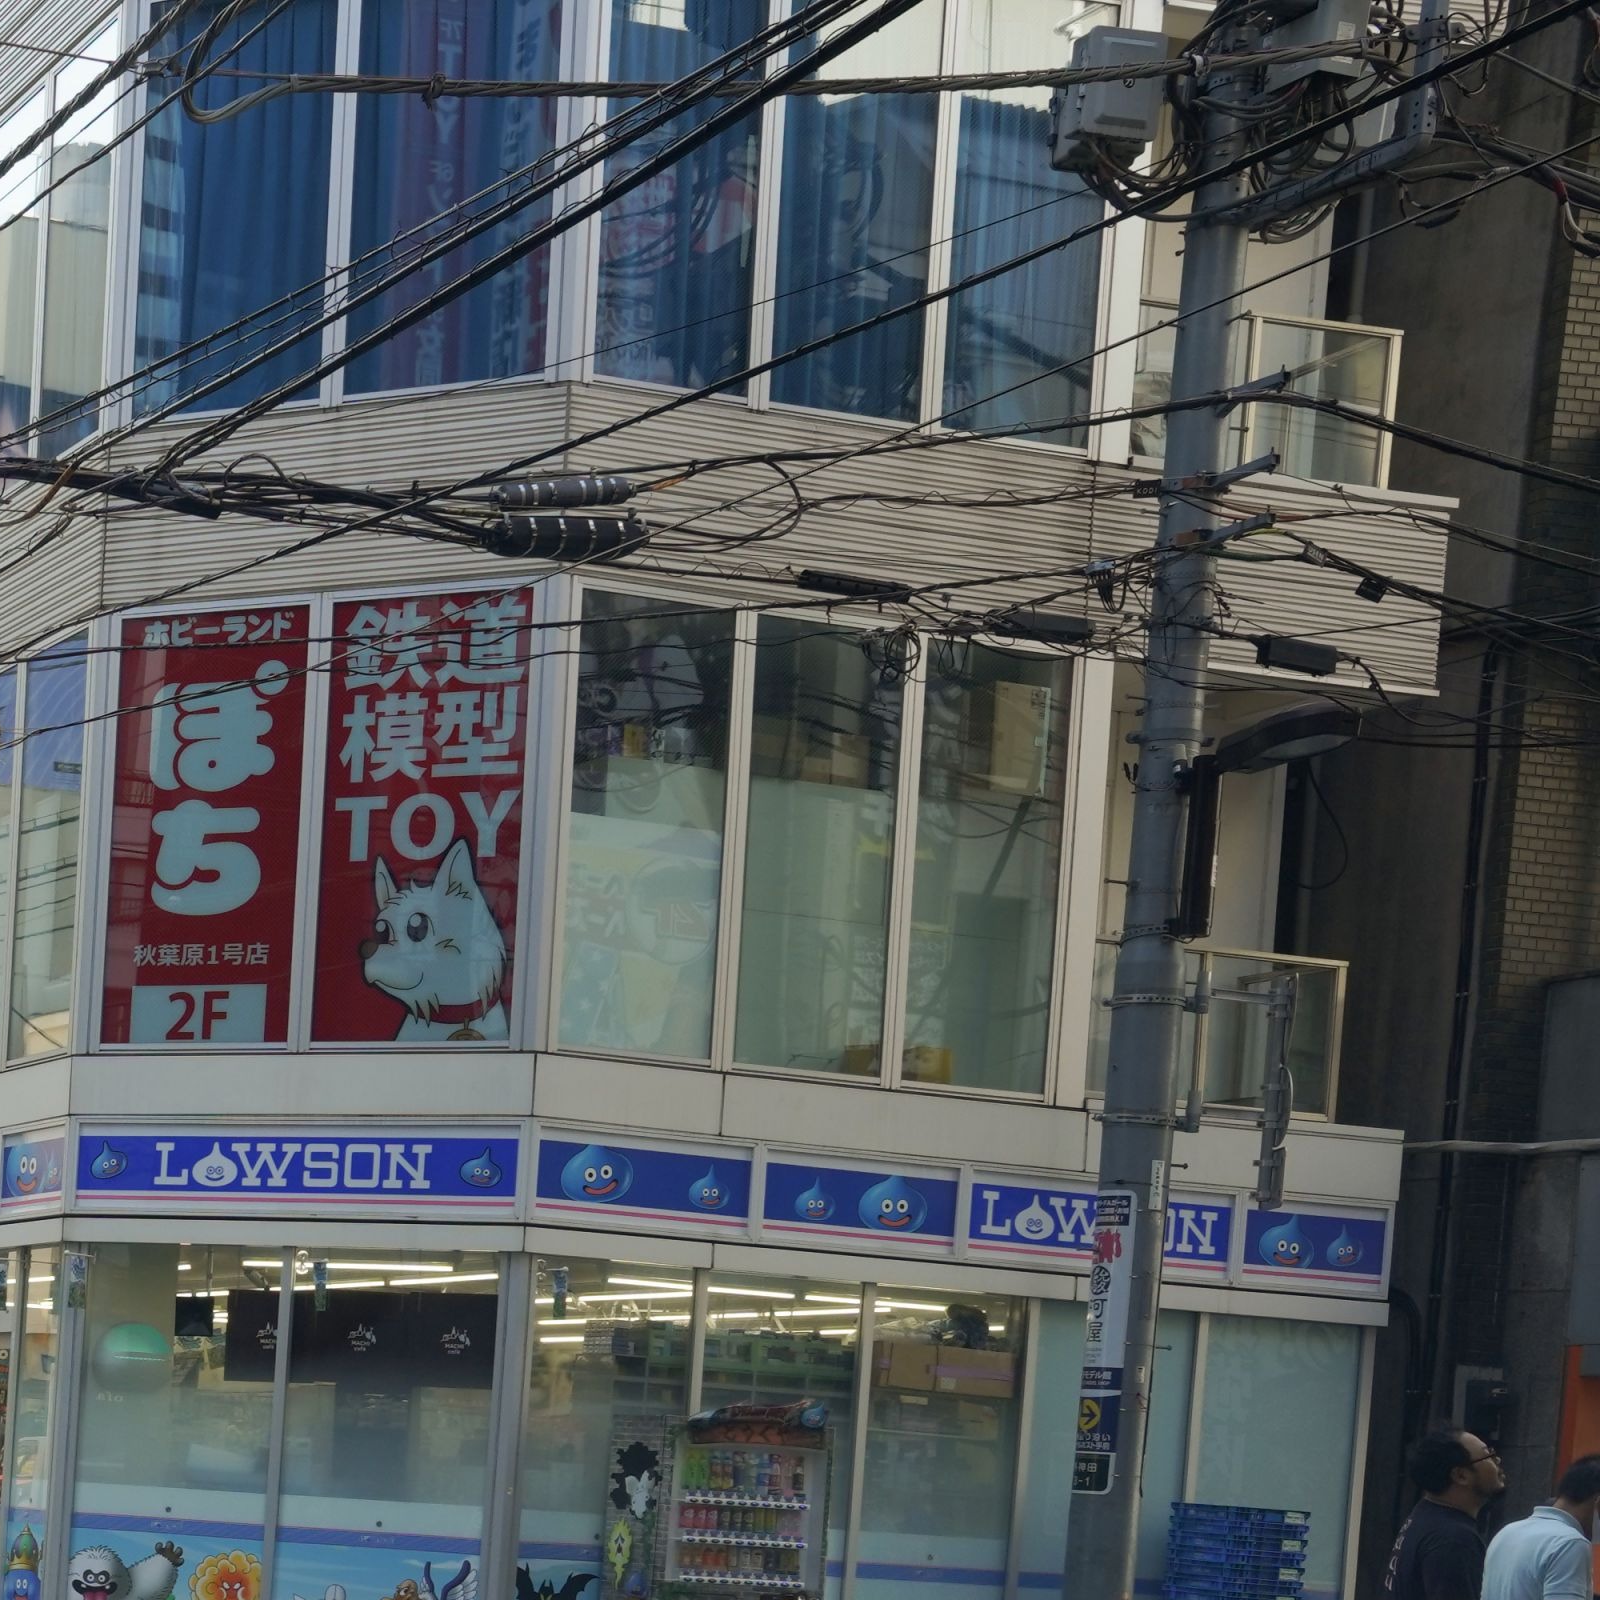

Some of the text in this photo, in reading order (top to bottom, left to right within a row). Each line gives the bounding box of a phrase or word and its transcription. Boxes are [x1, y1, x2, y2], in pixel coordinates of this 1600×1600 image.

[144, 610, 296, 646] ホビーランド
[345, 591, 528, 691] 鉄道
[340, 686, 520, 784] 模型
[150, 659, 290, 916] ぽち
[335, 788, 523, 862] TOY
[133, 942, 270, 968] 秋葉原1号店
[165, 991, 229, 1041] 2F
